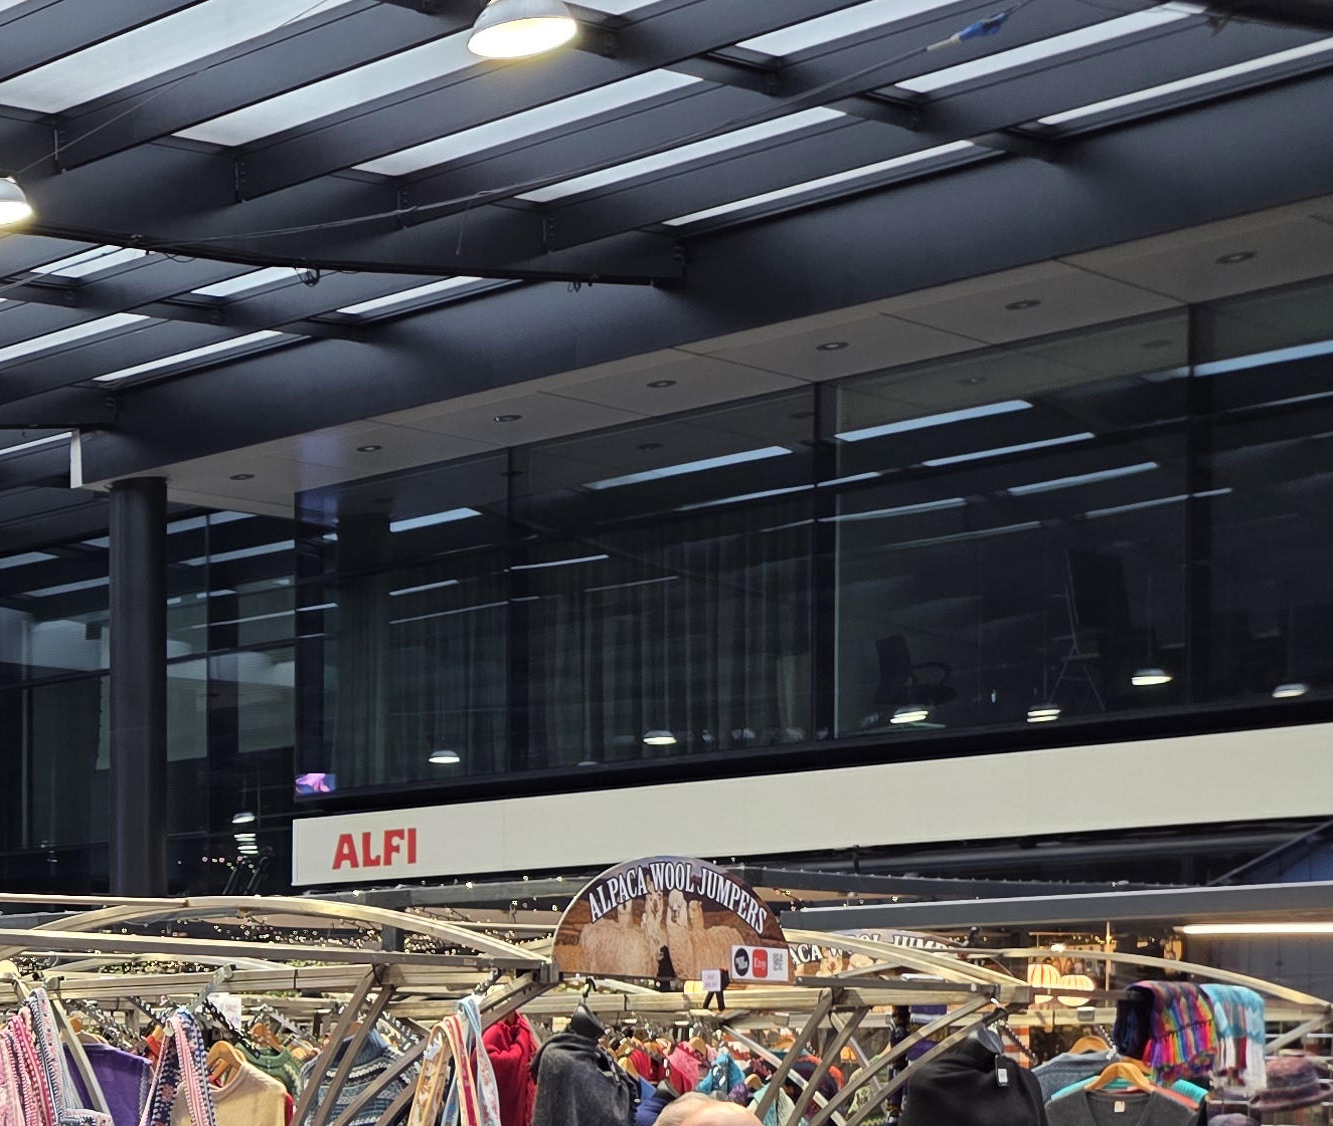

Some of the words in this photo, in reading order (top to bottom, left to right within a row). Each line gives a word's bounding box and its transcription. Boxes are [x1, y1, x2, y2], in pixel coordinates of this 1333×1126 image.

[332, 827, 417, 870] ALFI
[588, 866, 648, 923] ALPACA
[649, 861, 695, 892] WOOL
[697, 868, 768, 935] JUMPERS
